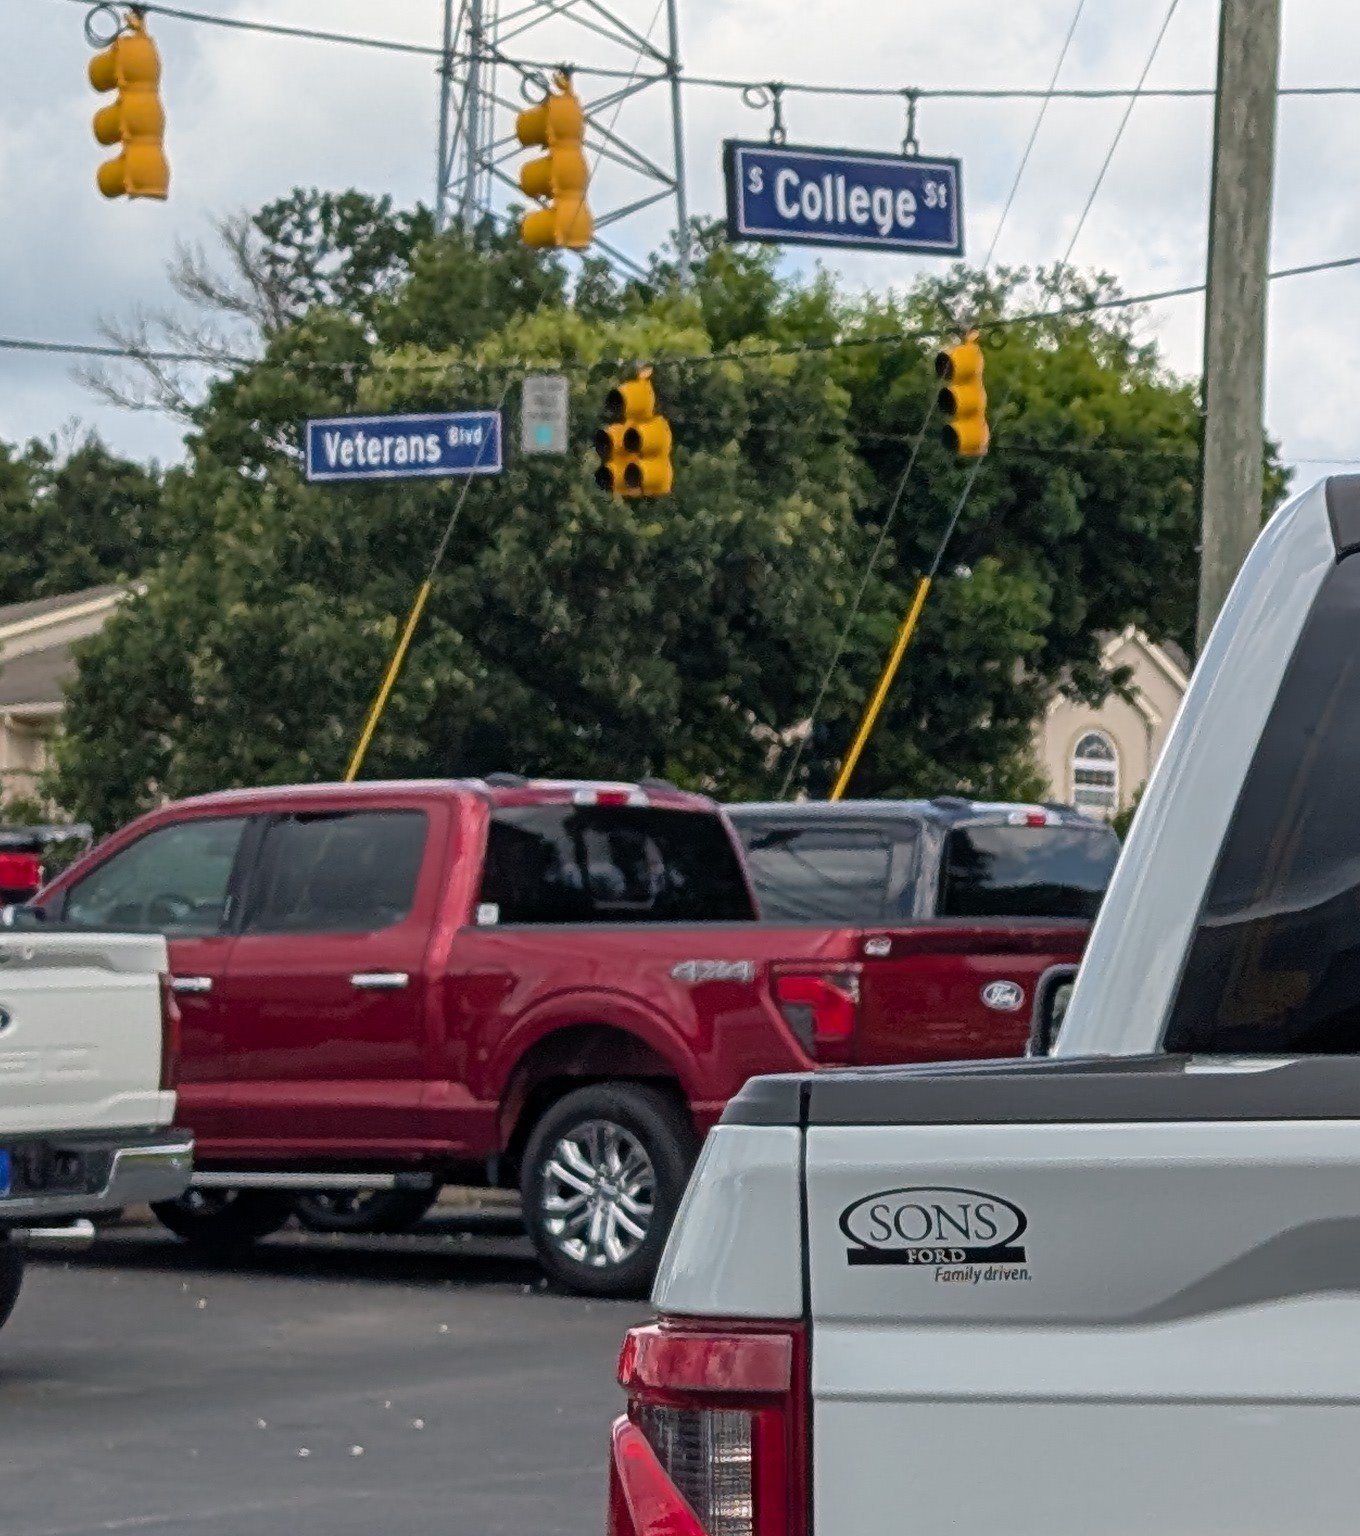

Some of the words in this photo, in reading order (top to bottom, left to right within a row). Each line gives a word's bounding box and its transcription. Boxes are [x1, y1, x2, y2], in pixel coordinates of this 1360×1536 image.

[749, 166, 764, 195] S
[775, 168, 918, 236] College
[924, 180, 948, 209] St
[324, 430, 443, 468] Veterans
[447, 425, 483, 447] Blvd
[869, 1202, 998, 1242] SONS
[906, 1248, 967, 1264] FORD
[934, 1265, 981, 1285] Family
[983, 1264, 1032, 1282] driven.
